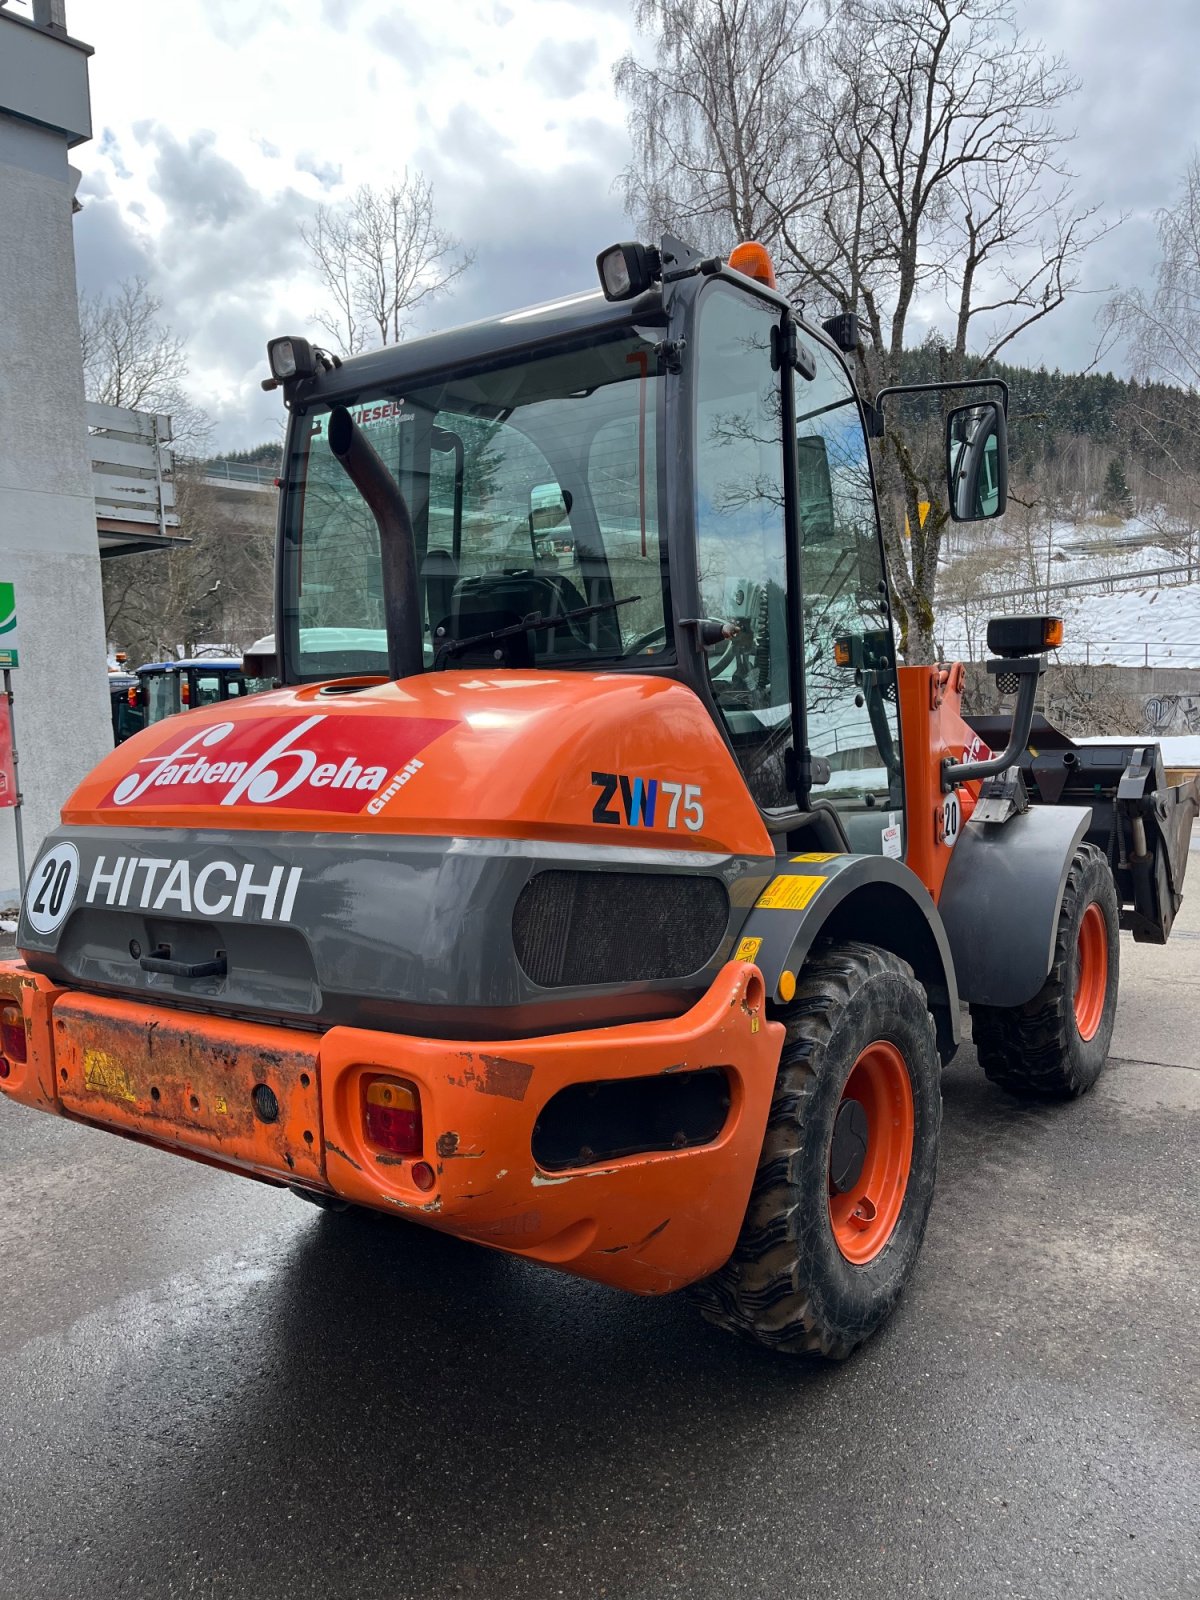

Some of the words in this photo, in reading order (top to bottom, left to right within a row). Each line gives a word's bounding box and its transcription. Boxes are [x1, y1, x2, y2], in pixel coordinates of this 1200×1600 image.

[351, 402, 402, 425] IESEL
[367, 758, 424, 815] GmbH
[945, 803, 957, 836] 20
[32, 858, 71, 916] 20
[86, 855, 302, 922] HITACHI
